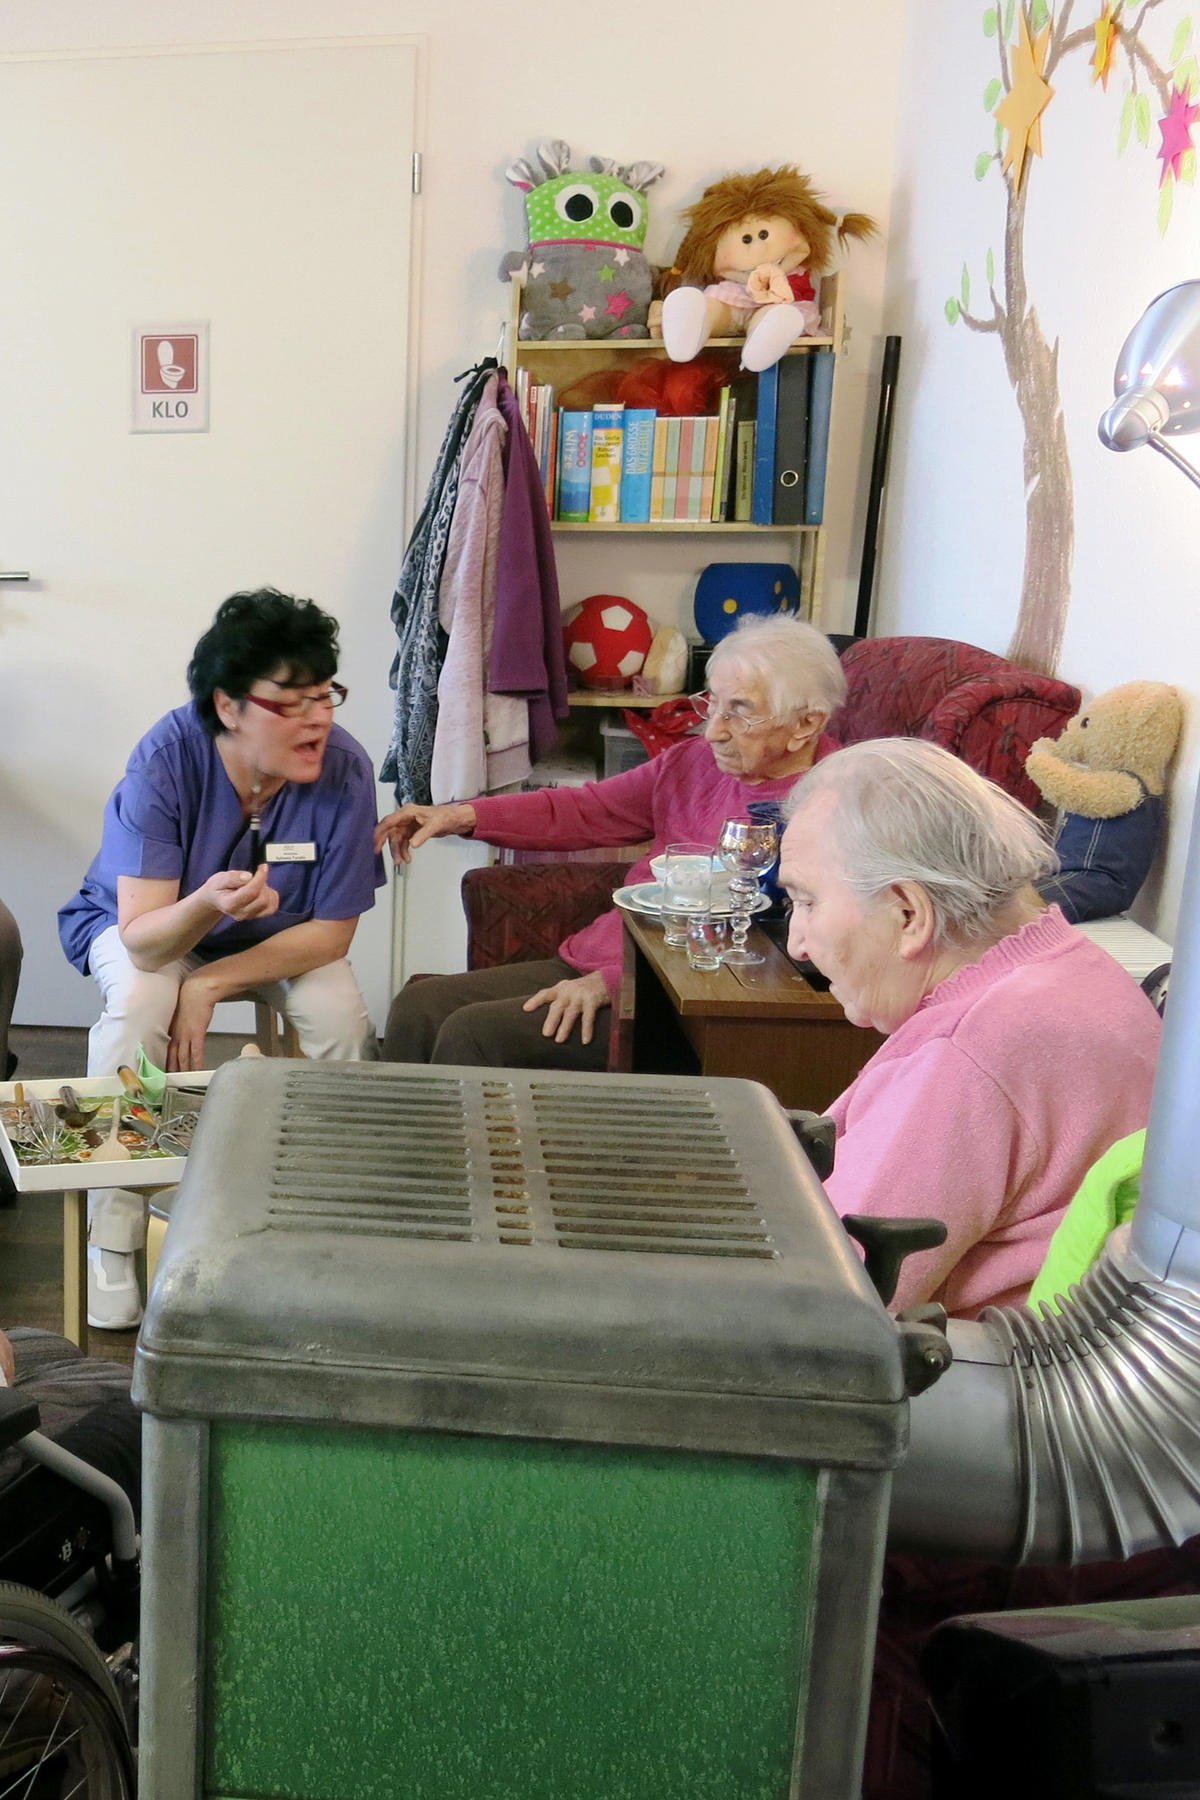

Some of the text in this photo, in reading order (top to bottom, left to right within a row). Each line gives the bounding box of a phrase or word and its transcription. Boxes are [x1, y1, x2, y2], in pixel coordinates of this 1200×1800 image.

[152, 400, 188, 418] KLO
[594, 413, 622, 421] DUDEN
[625, 422, 639, 474] DAS GROSSE
[637, 419, 649, 474] WITZEBUCH
